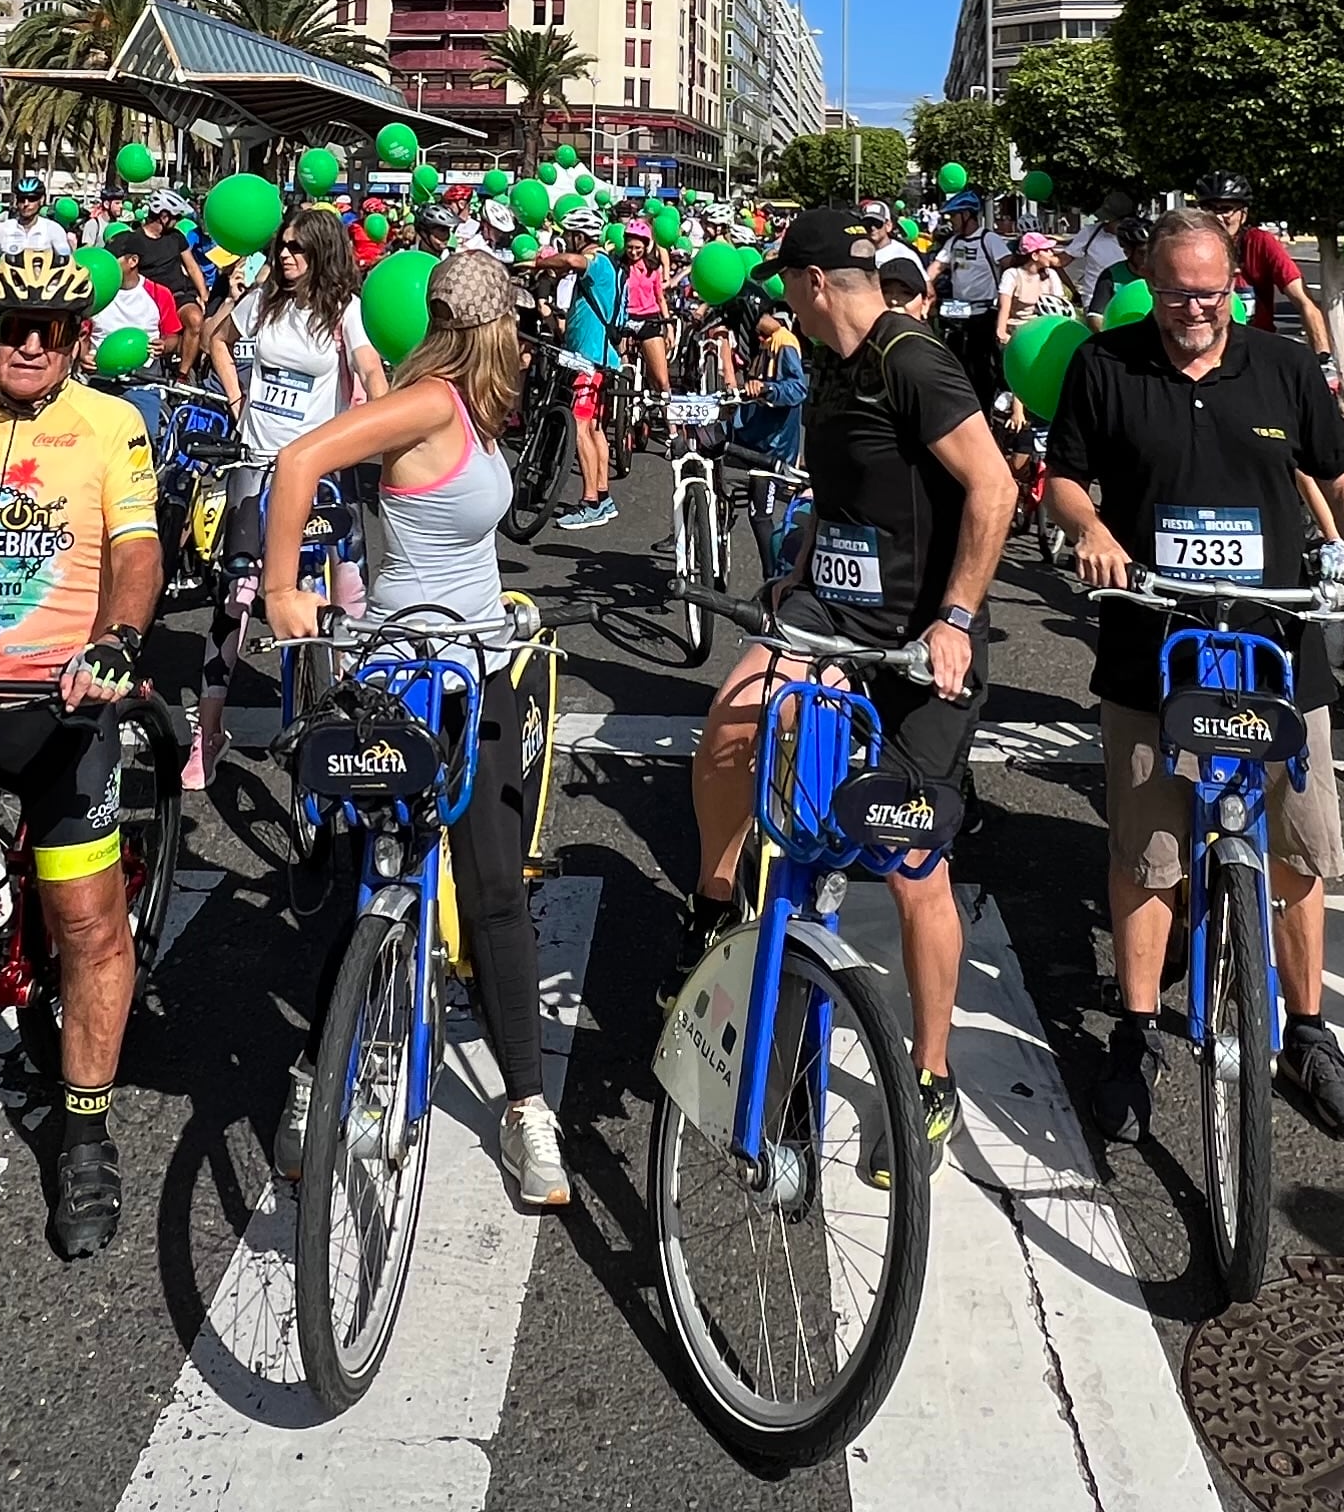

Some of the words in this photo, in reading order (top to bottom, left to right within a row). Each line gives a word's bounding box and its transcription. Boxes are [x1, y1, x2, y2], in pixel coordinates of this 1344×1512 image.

[264, 385, 298, 407] 1711
[1173, 537, 1244, 566] 7333
[815, 553, 862, 588] 7309
[327, 753, 408, 774] SITYCLETA
[678, 1010, 733, 1088] SAGULPA
